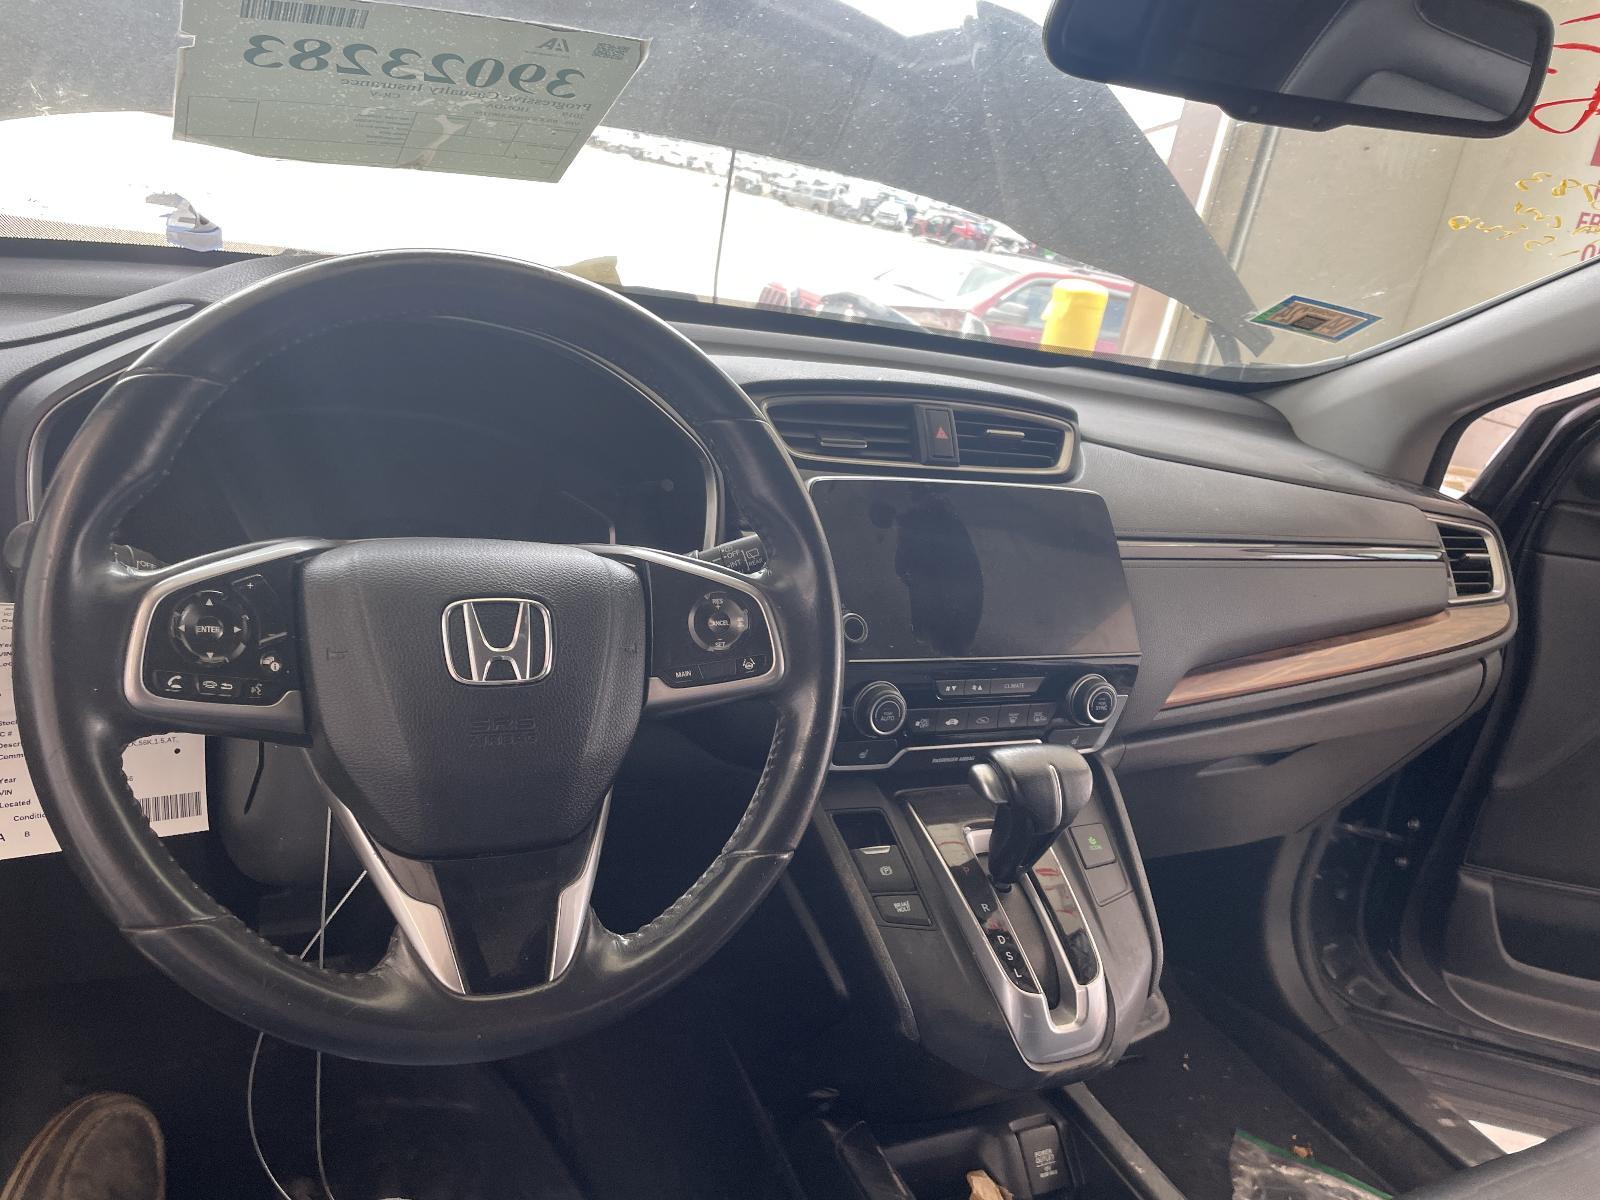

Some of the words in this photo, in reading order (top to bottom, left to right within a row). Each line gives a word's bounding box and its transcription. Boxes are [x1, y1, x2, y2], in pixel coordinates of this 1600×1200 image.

[195, 625, 223, 634] ENTER
[675, 670, 692, 679] MAIN
[981, 903, 990, 912] R
[997, 935, 1006, 945] D
[1005, 951, 1014, 961] S
[1013, 968, 1022, 978] L
